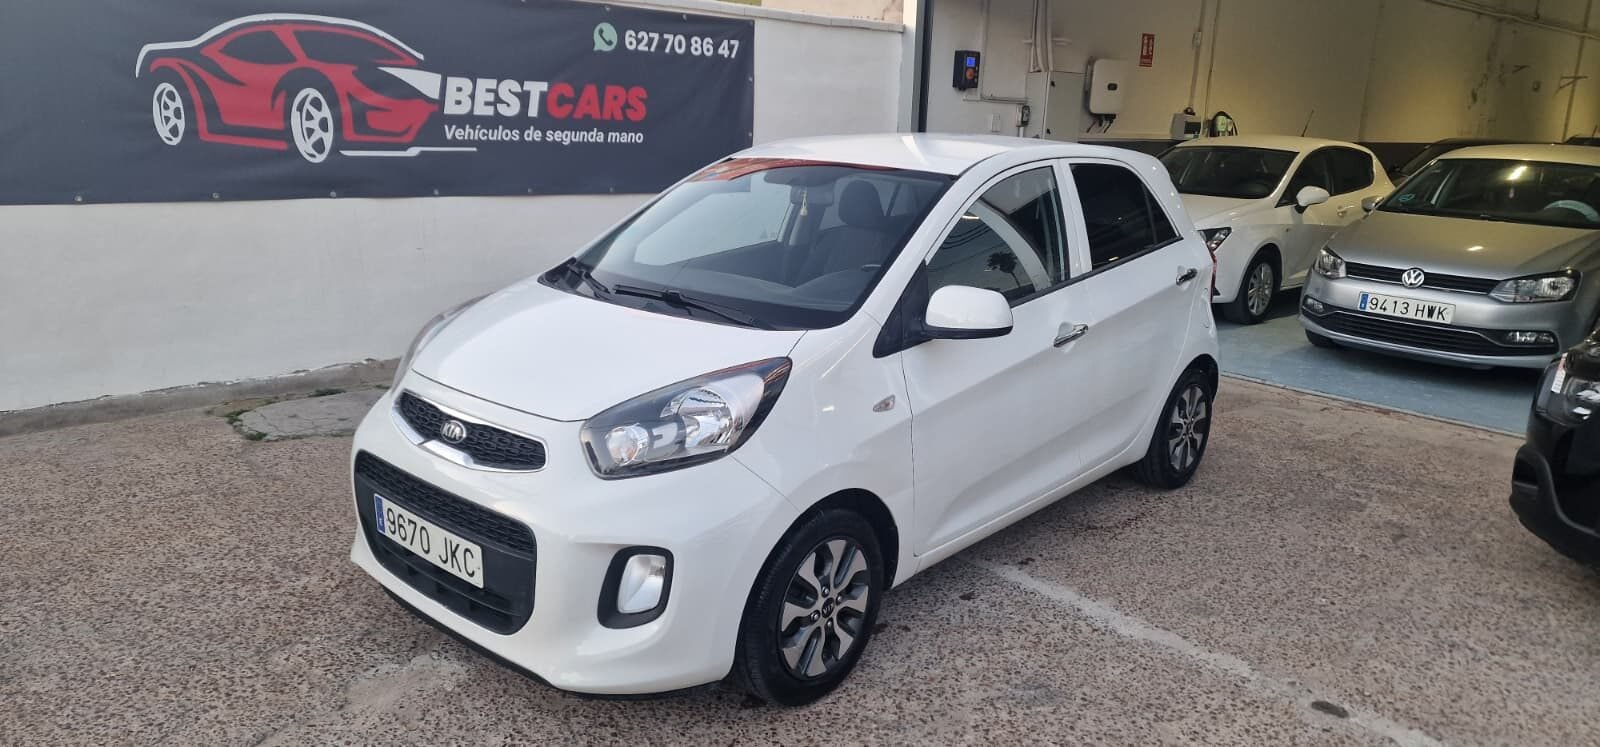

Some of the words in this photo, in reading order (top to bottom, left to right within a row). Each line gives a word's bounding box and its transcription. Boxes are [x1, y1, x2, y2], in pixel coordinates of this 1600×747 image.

[624, 29, 659, 52] 627
[663, 33, 686, 54] 70
[690, 36, 714, 57] 86
[717, 39, 740, 59] 47
[444, 124, 520, 141] Vehículos
[523, 126, 543, 142] de
[545, 128, 604, 145] segunda
[607, 130, 644, 144] mano
[1369, 297, 1410, 315] 9413
[1414, 303, 1448, 321] HWK
[442, 422, 462, 441] KIA
[386, 507, 430, 554] 9670
[438, 536, 475, 578] JKC
